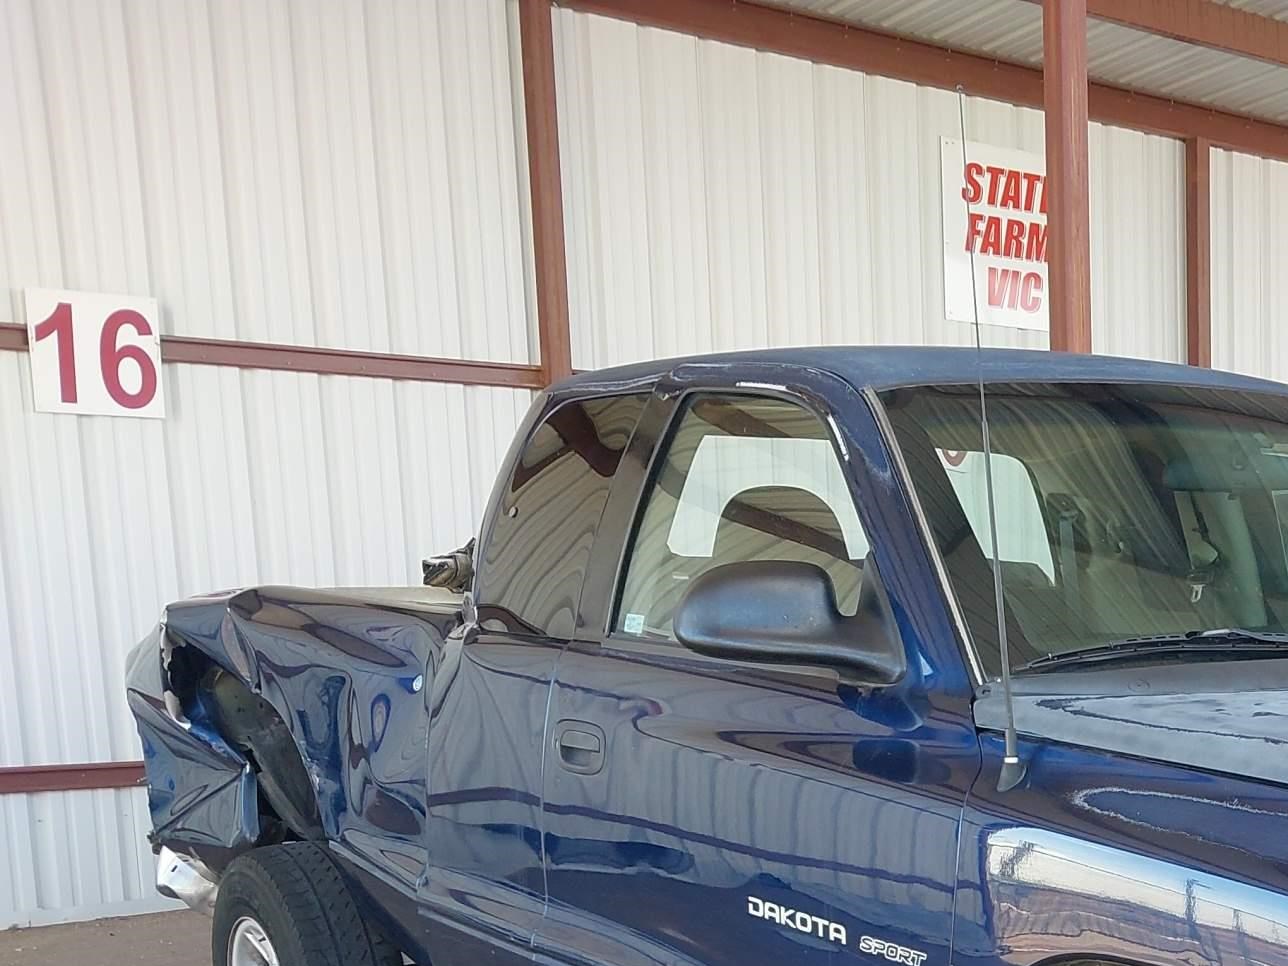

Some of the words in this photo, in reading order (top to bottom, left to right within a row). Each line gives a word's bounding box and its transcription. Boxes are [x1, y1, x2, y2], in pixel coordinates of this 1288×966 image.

[987, 266, 1043, 313] VIC
[34, 301, 158, 410] 16
[747, 896, 847, 945] DAKOTA
